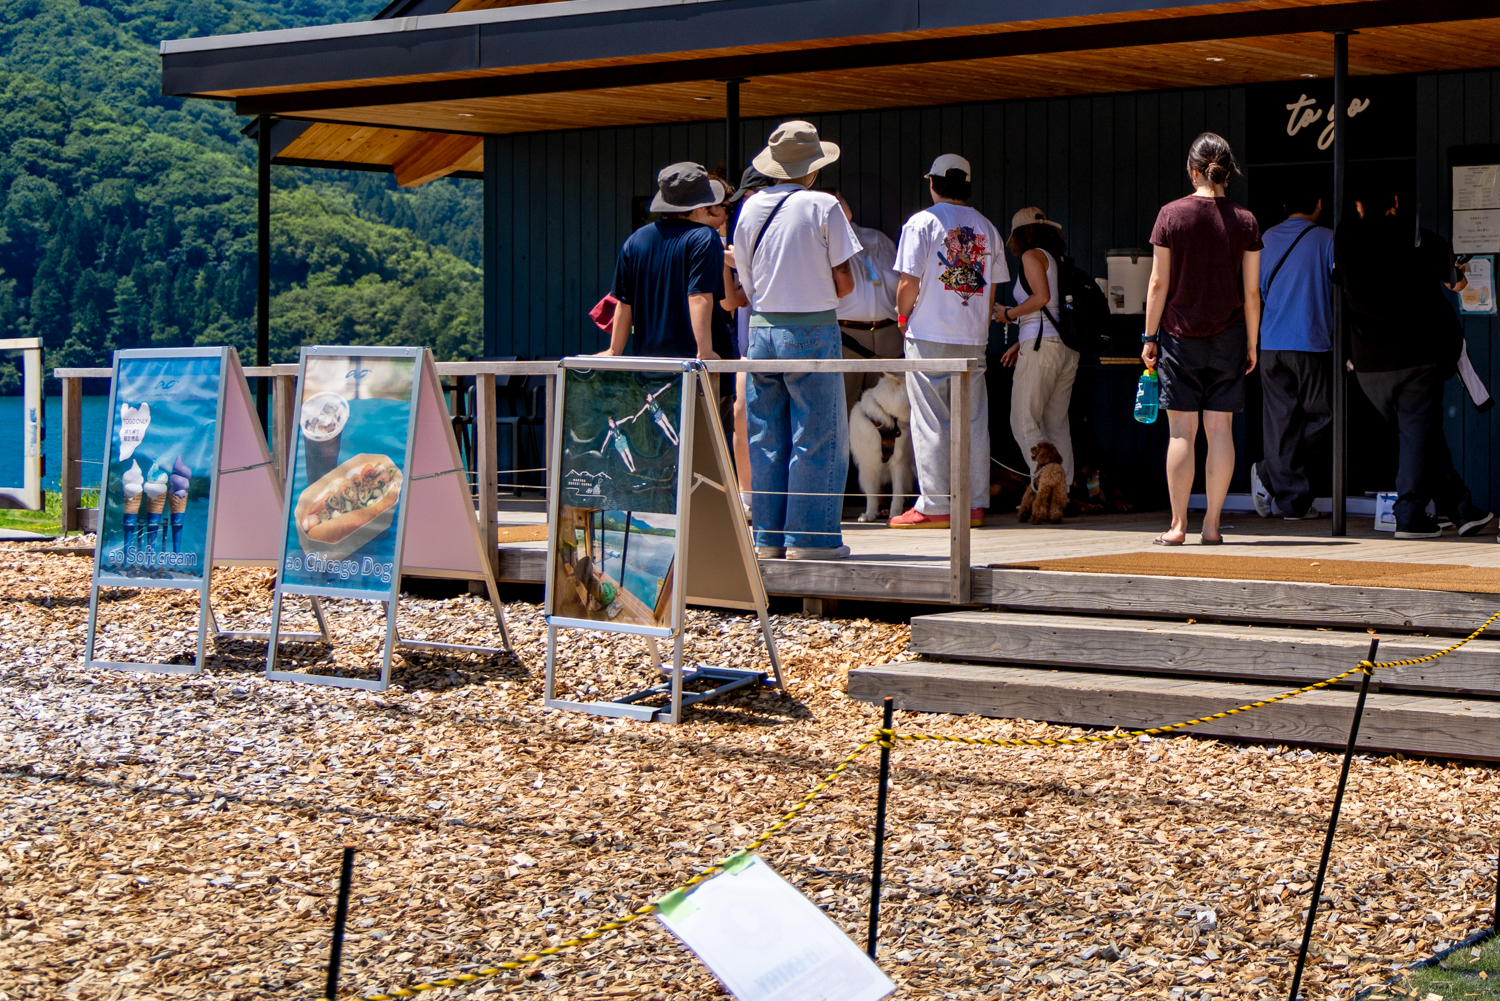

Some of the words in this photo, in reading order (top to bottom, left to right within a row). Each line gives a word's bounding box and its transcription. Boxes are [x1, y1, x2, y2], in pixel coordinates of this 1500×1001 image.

[1286, 93, 1323, 136] to
[109, 550, 125, 564] ao
[126, 545, 156, 565] Soft
[157, 551, 197, 566] cream
[285, 556, 302, 571] ao
[304, 552, 359, 580] Chicago
[361, 556, 393, 583] Dog
